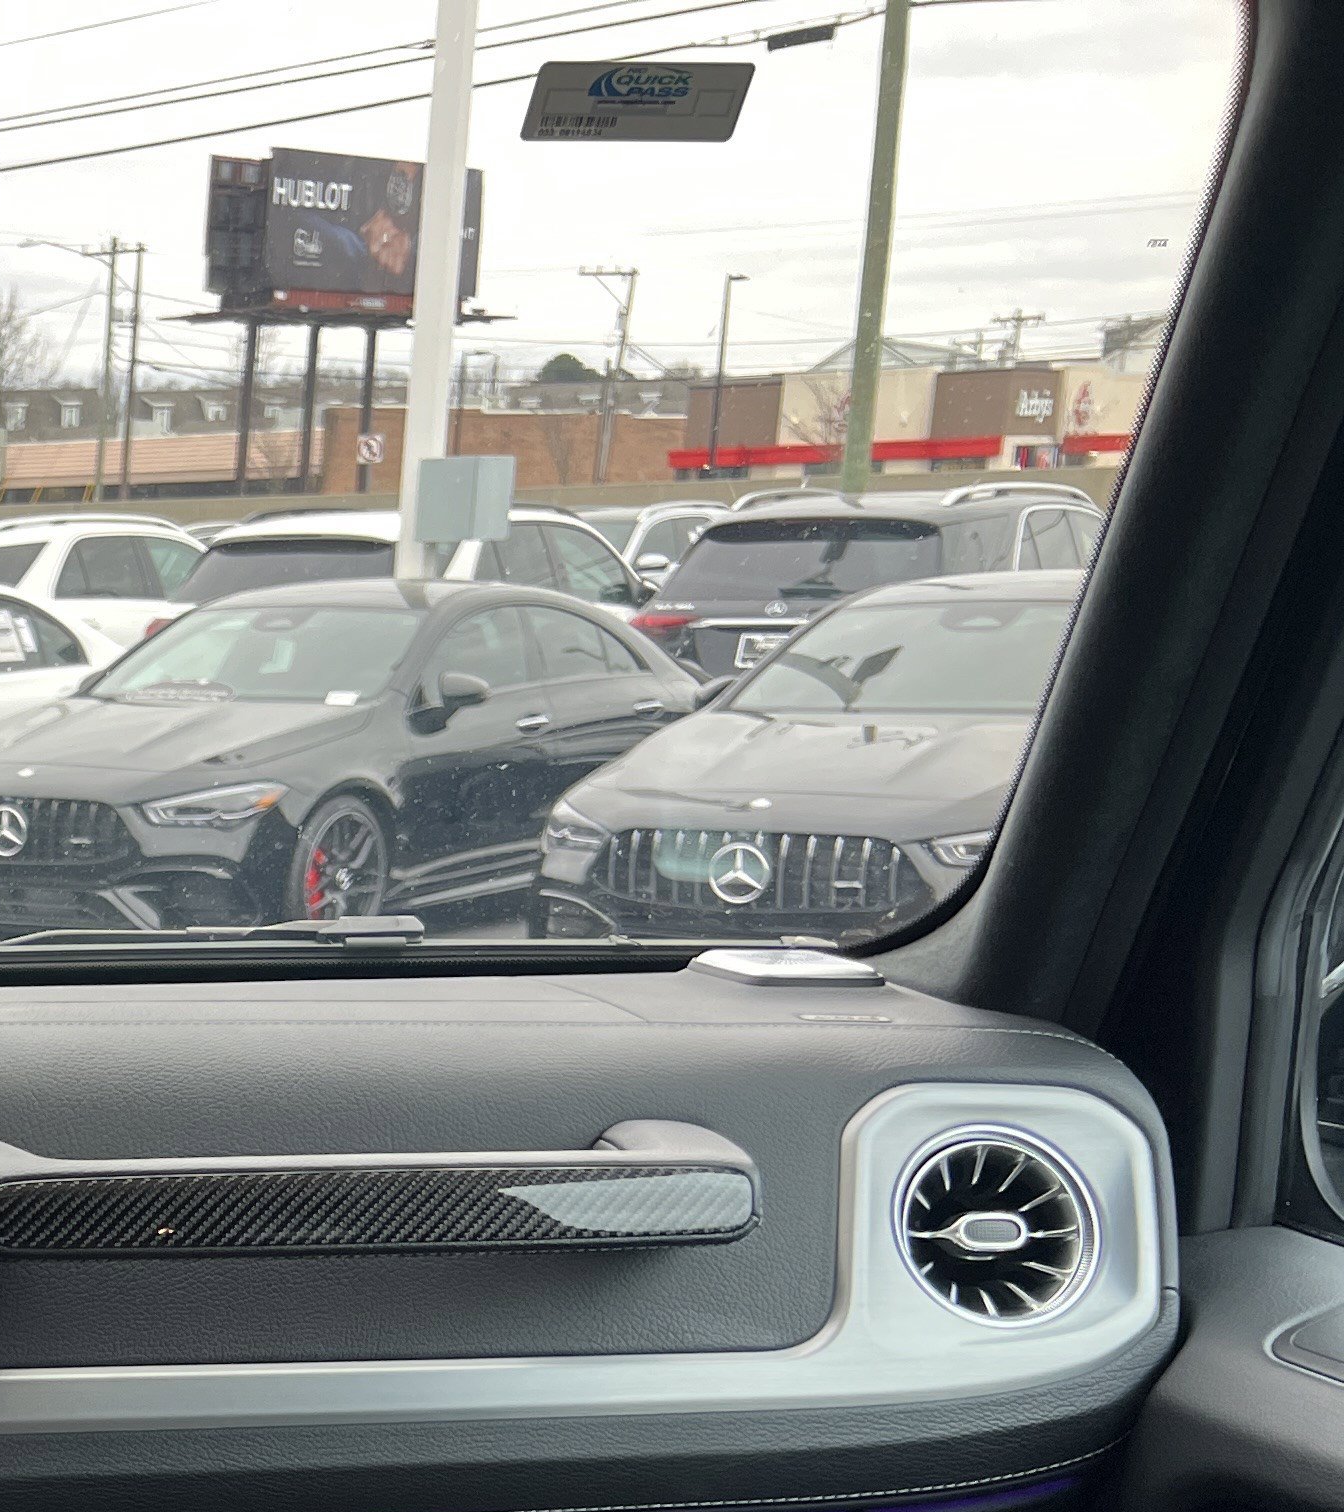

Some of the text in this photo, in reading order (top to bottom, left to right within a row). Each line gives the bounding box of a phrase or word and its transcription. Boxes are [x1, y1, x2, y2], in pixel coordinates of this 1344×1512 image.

[615, 74, 692, 87] QUICK
[624, 87, 690, 97] PASS
[272, 176, 354, 211] HUBLOT
